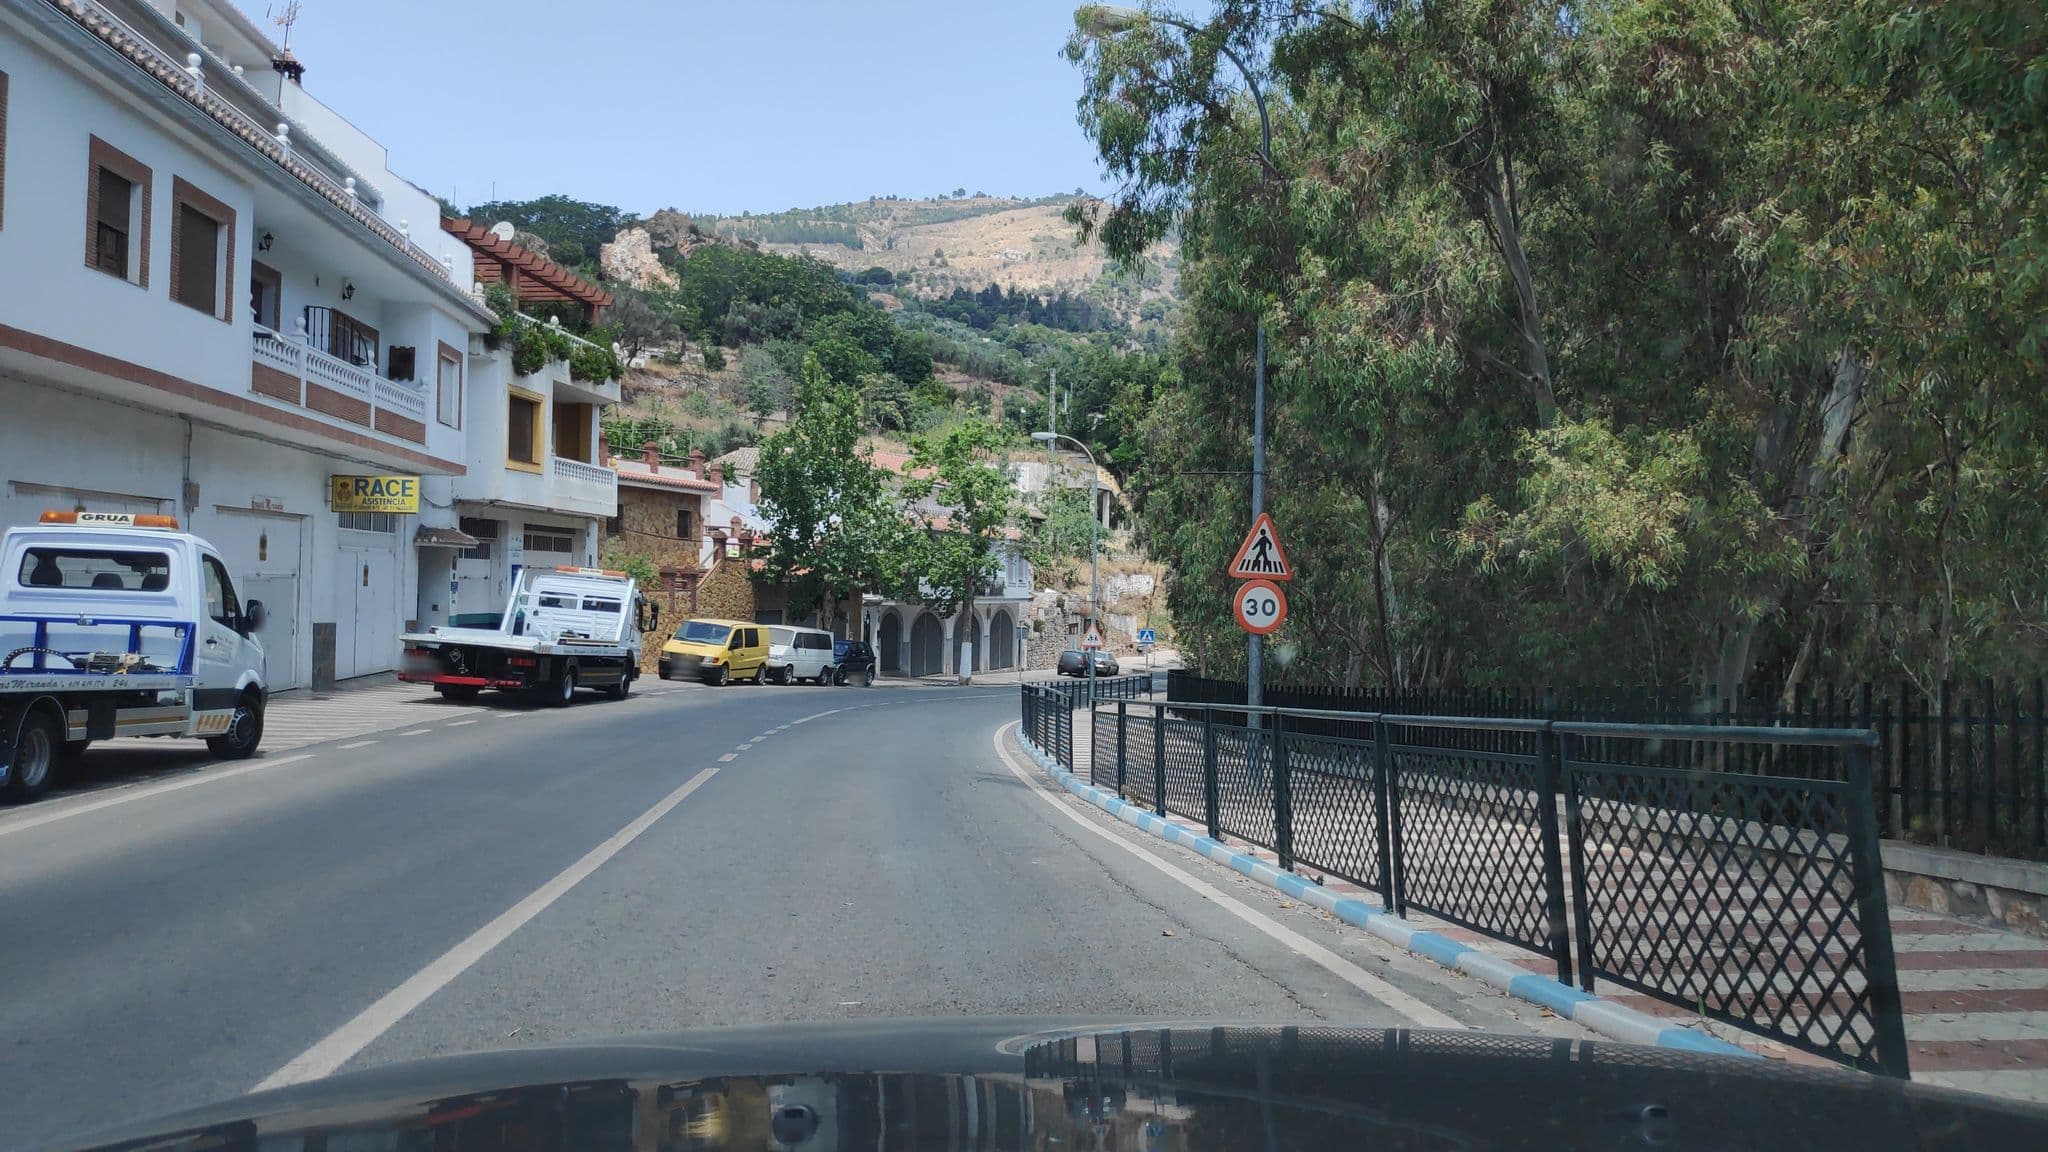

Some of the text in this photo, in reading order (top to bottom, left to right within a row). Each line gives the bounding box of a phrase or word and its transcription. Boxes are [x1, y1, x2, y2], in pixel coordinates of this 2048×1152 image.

[354, 478, 414, 497] RACE
[362, 498, 406, 506] ASISTENCIA
[81, 513, 131, 523] GRUA
[1246, 598, 1277, 617] 30
